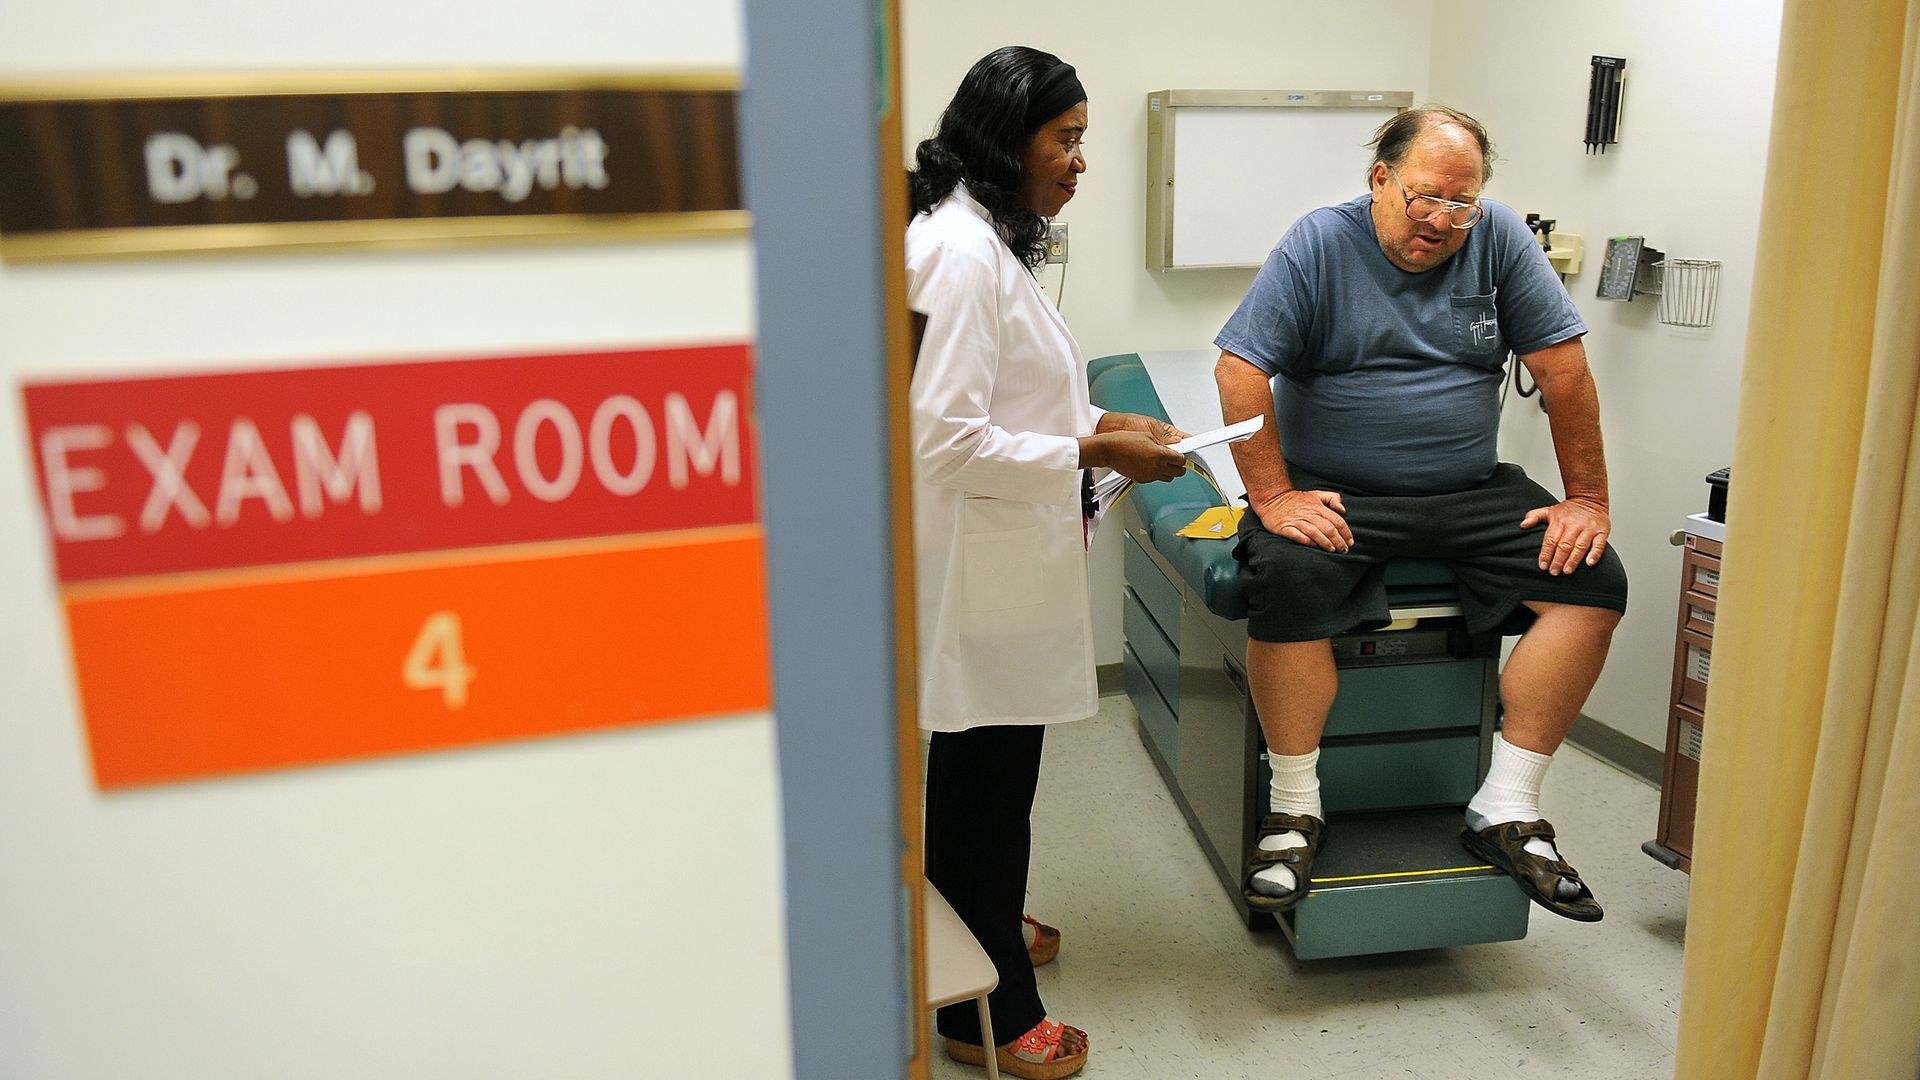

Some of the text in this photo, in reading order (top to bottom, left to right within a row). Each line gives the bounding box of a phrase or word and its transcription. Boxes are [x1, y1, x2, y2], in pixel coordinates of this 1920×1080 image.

[144, 127, 607, 202] Dr. M. Dayrit
[40, 389, 741, 542] EXAM ROOM
[402, 611, 474, 707] 4
